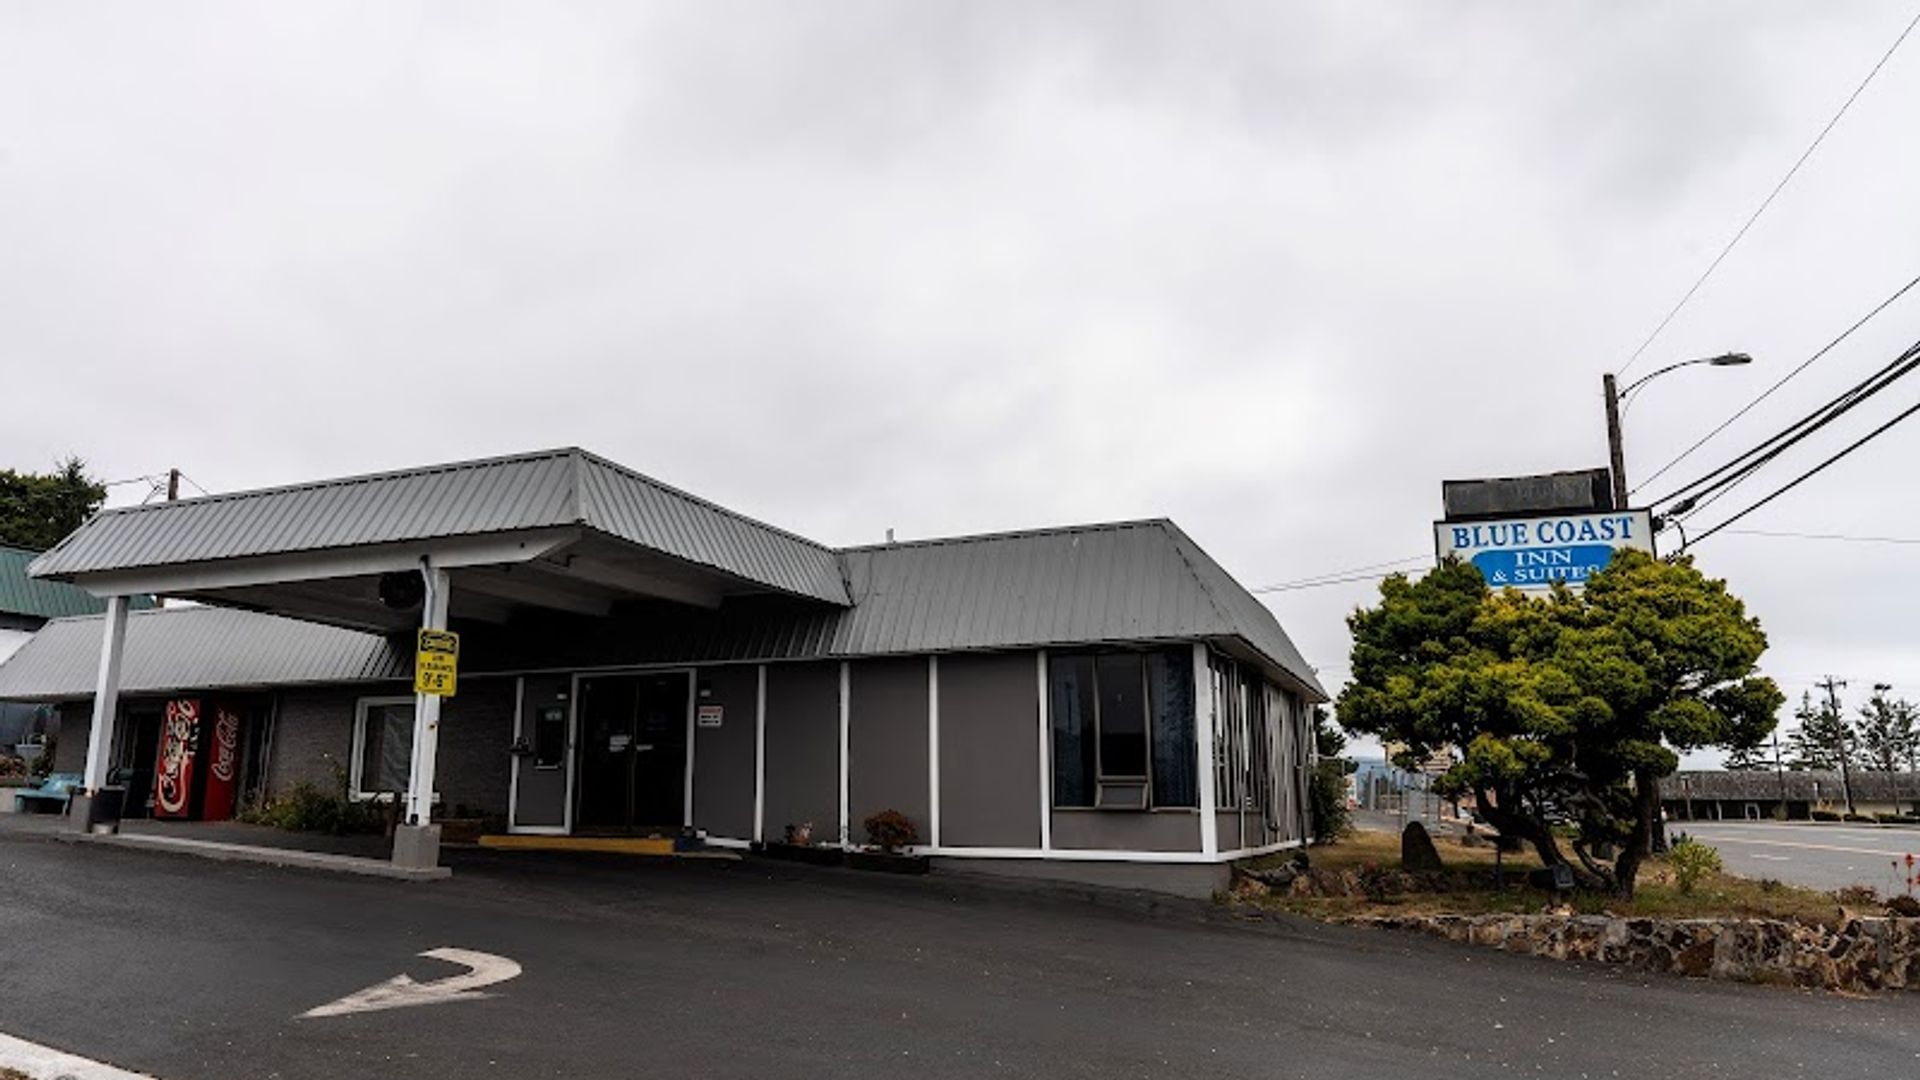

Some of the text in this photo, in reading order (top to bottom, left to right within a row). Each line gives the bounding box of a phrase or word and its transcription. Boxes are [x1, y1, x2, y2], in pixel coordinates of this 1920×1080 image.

[1452, 516, 1634, 548] BLUE COAST
[1515, 550, 1572, 567] INN
[1492, 571, 1508, 582] &
